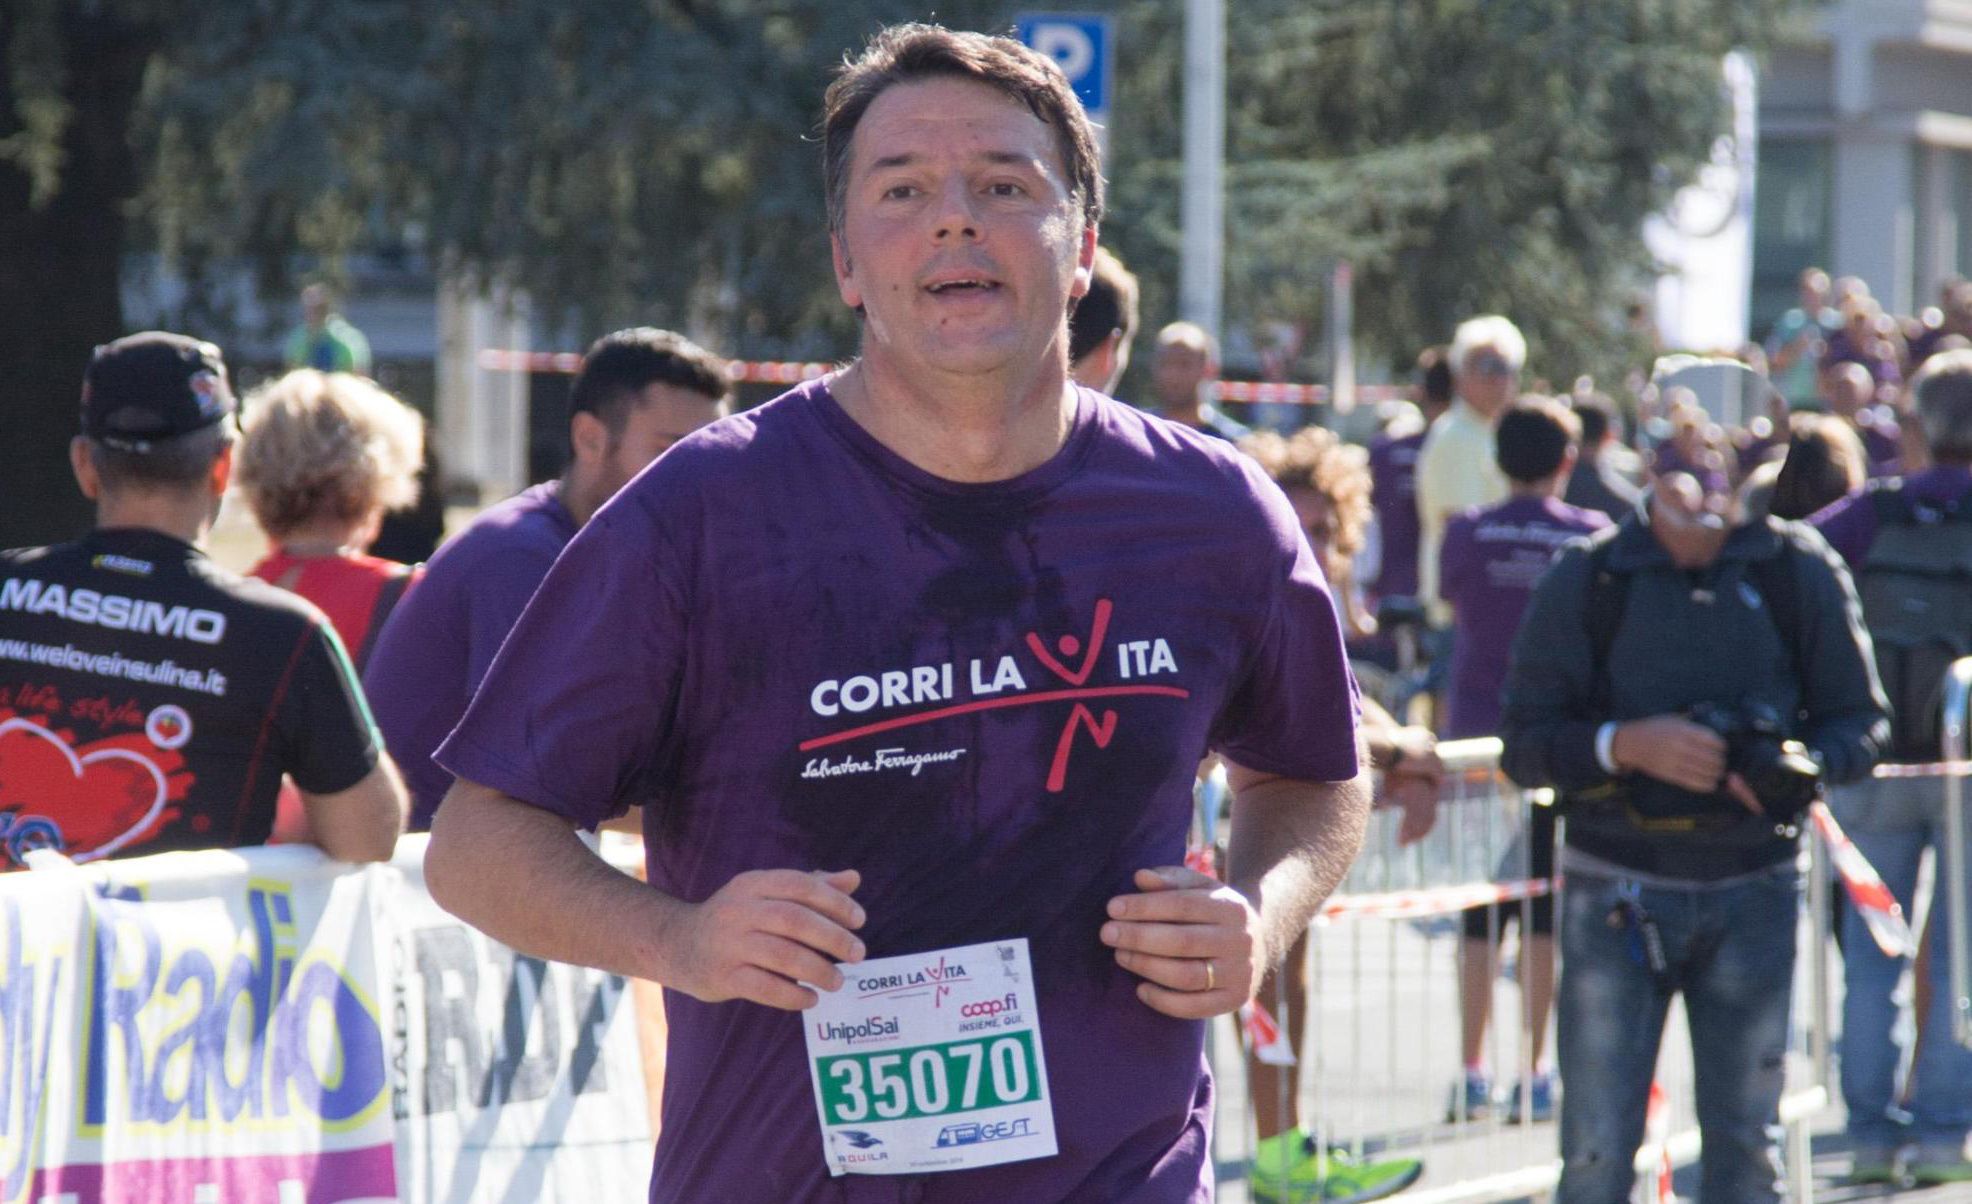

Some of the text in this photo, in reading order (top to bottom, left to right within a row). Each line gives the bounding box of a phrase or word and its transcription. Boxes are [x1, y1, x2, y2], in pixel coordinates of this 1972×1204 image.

[1031, 23, 1094, 80] P
[0, 578, 226, 645] MASSIMO
[810, 662, 953, 716] CORRI
[970, 656, 1026, 695] LA
[801, 747, 967, 778] Salvatore Ferragamo
[858, 974, 902, 991] CORRI
[907, 970, 926, 985] LA
[80, 878, 388, 1134] Radio
[961, 993, 1018, 1017] coop.fi
[817, 1016, 899, 1044] UnipolSai
[830, 1037, 1029, 1121] 35070
[837, 1151, 888, 1163] AQUILA
